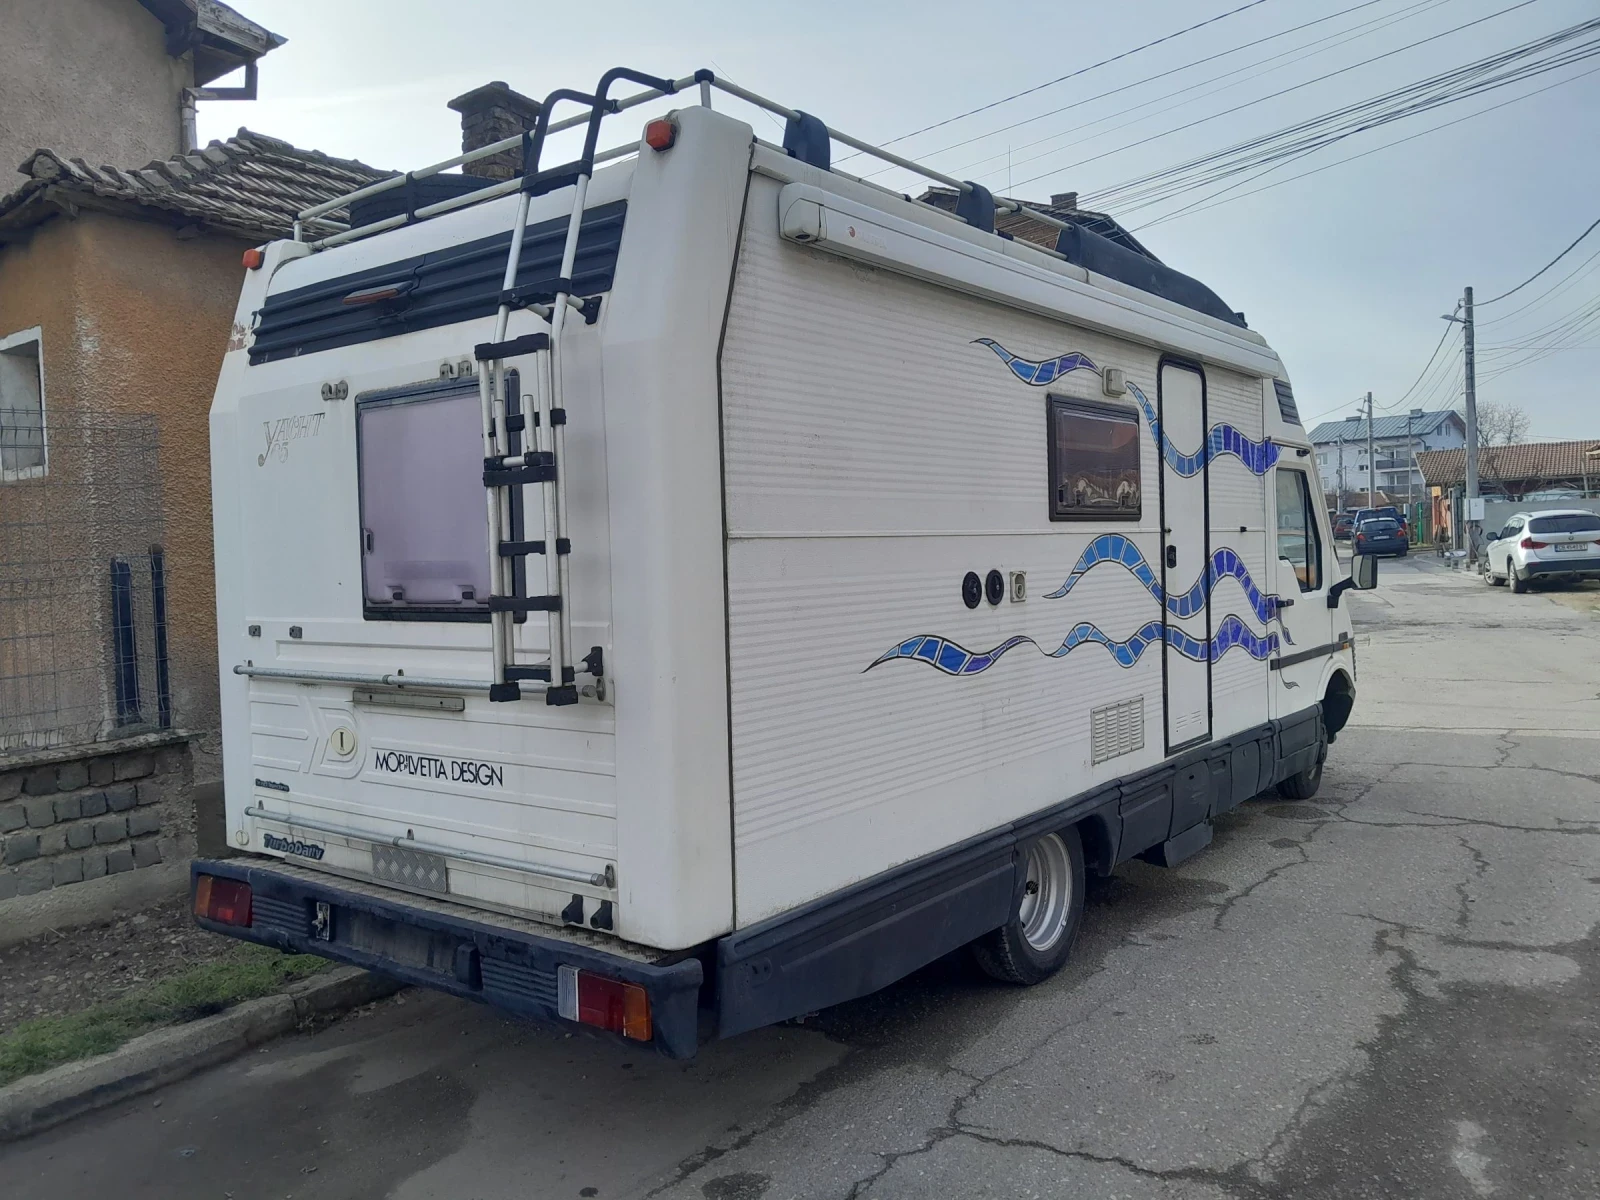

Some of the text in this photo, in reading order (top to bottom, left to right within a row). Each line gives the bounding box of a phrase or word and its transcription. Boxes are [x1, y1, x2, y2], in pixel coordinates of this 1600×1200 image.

[375, 751, 503, 787] MOBILVETTA DESIGN
[263, 834, 324, 860] TurboDaily
